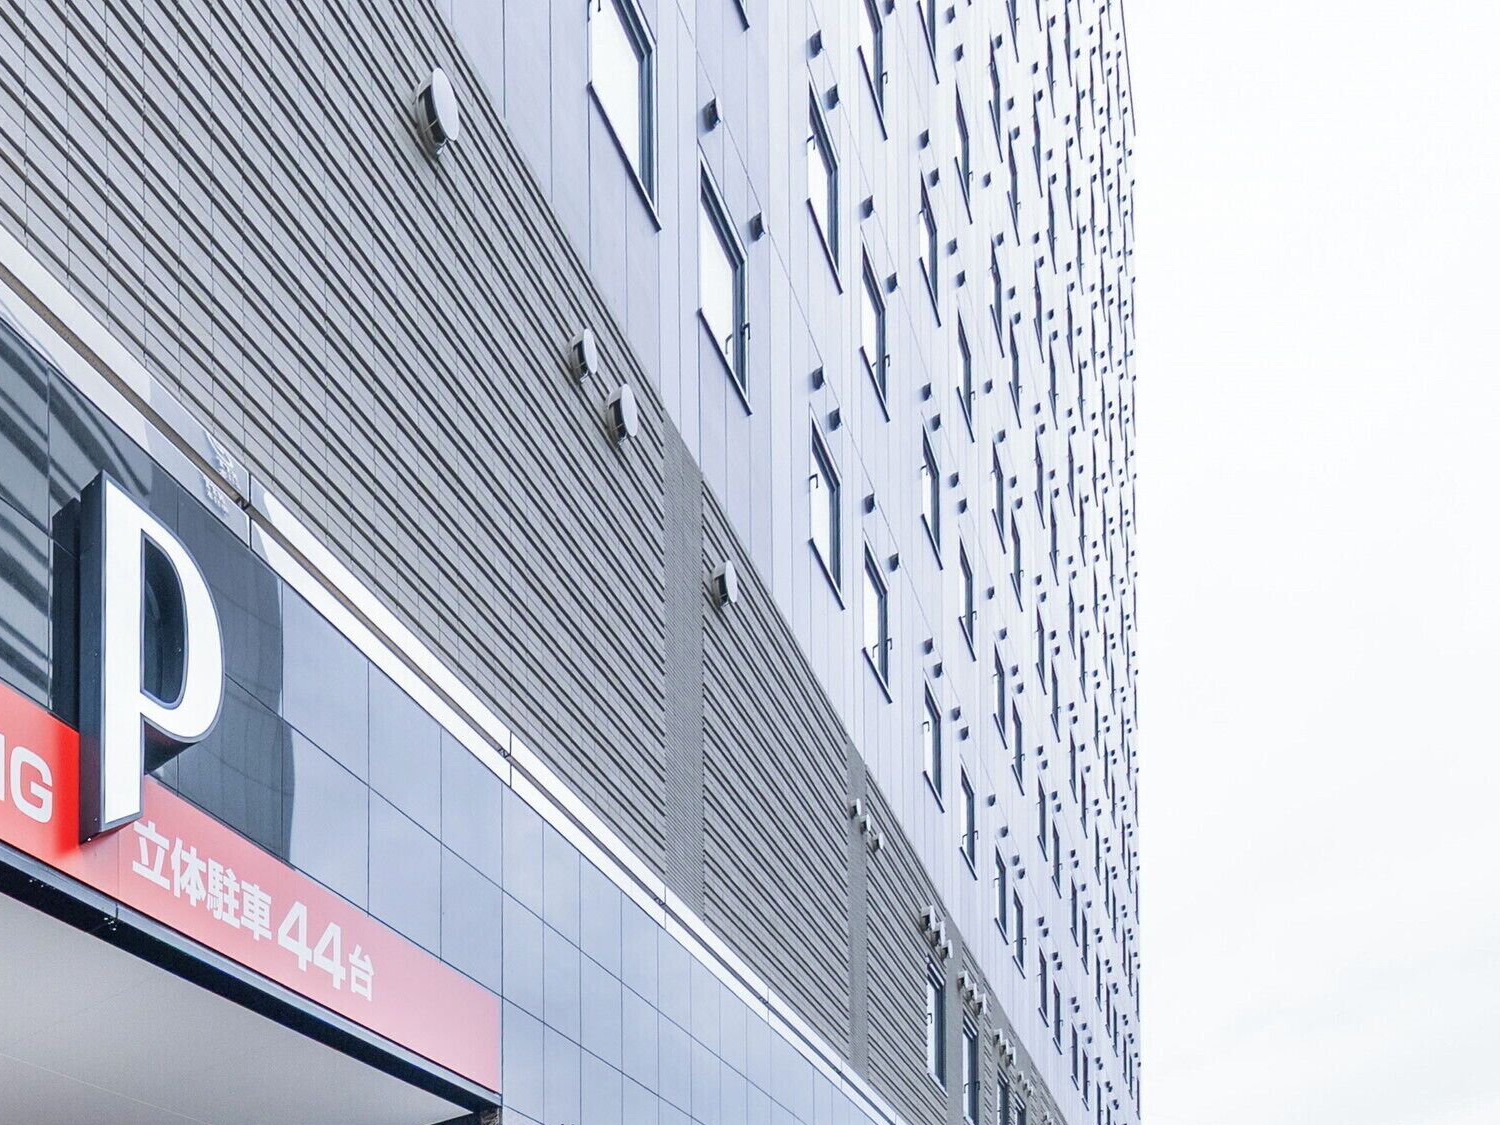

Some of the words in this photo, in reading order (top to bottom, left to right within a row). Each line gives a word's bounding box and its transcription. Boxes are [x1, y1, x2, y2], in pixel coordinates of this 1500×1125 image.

[102, 474, 226, 830] P
[132, 820, 375, 1002] 立体駐車44台
